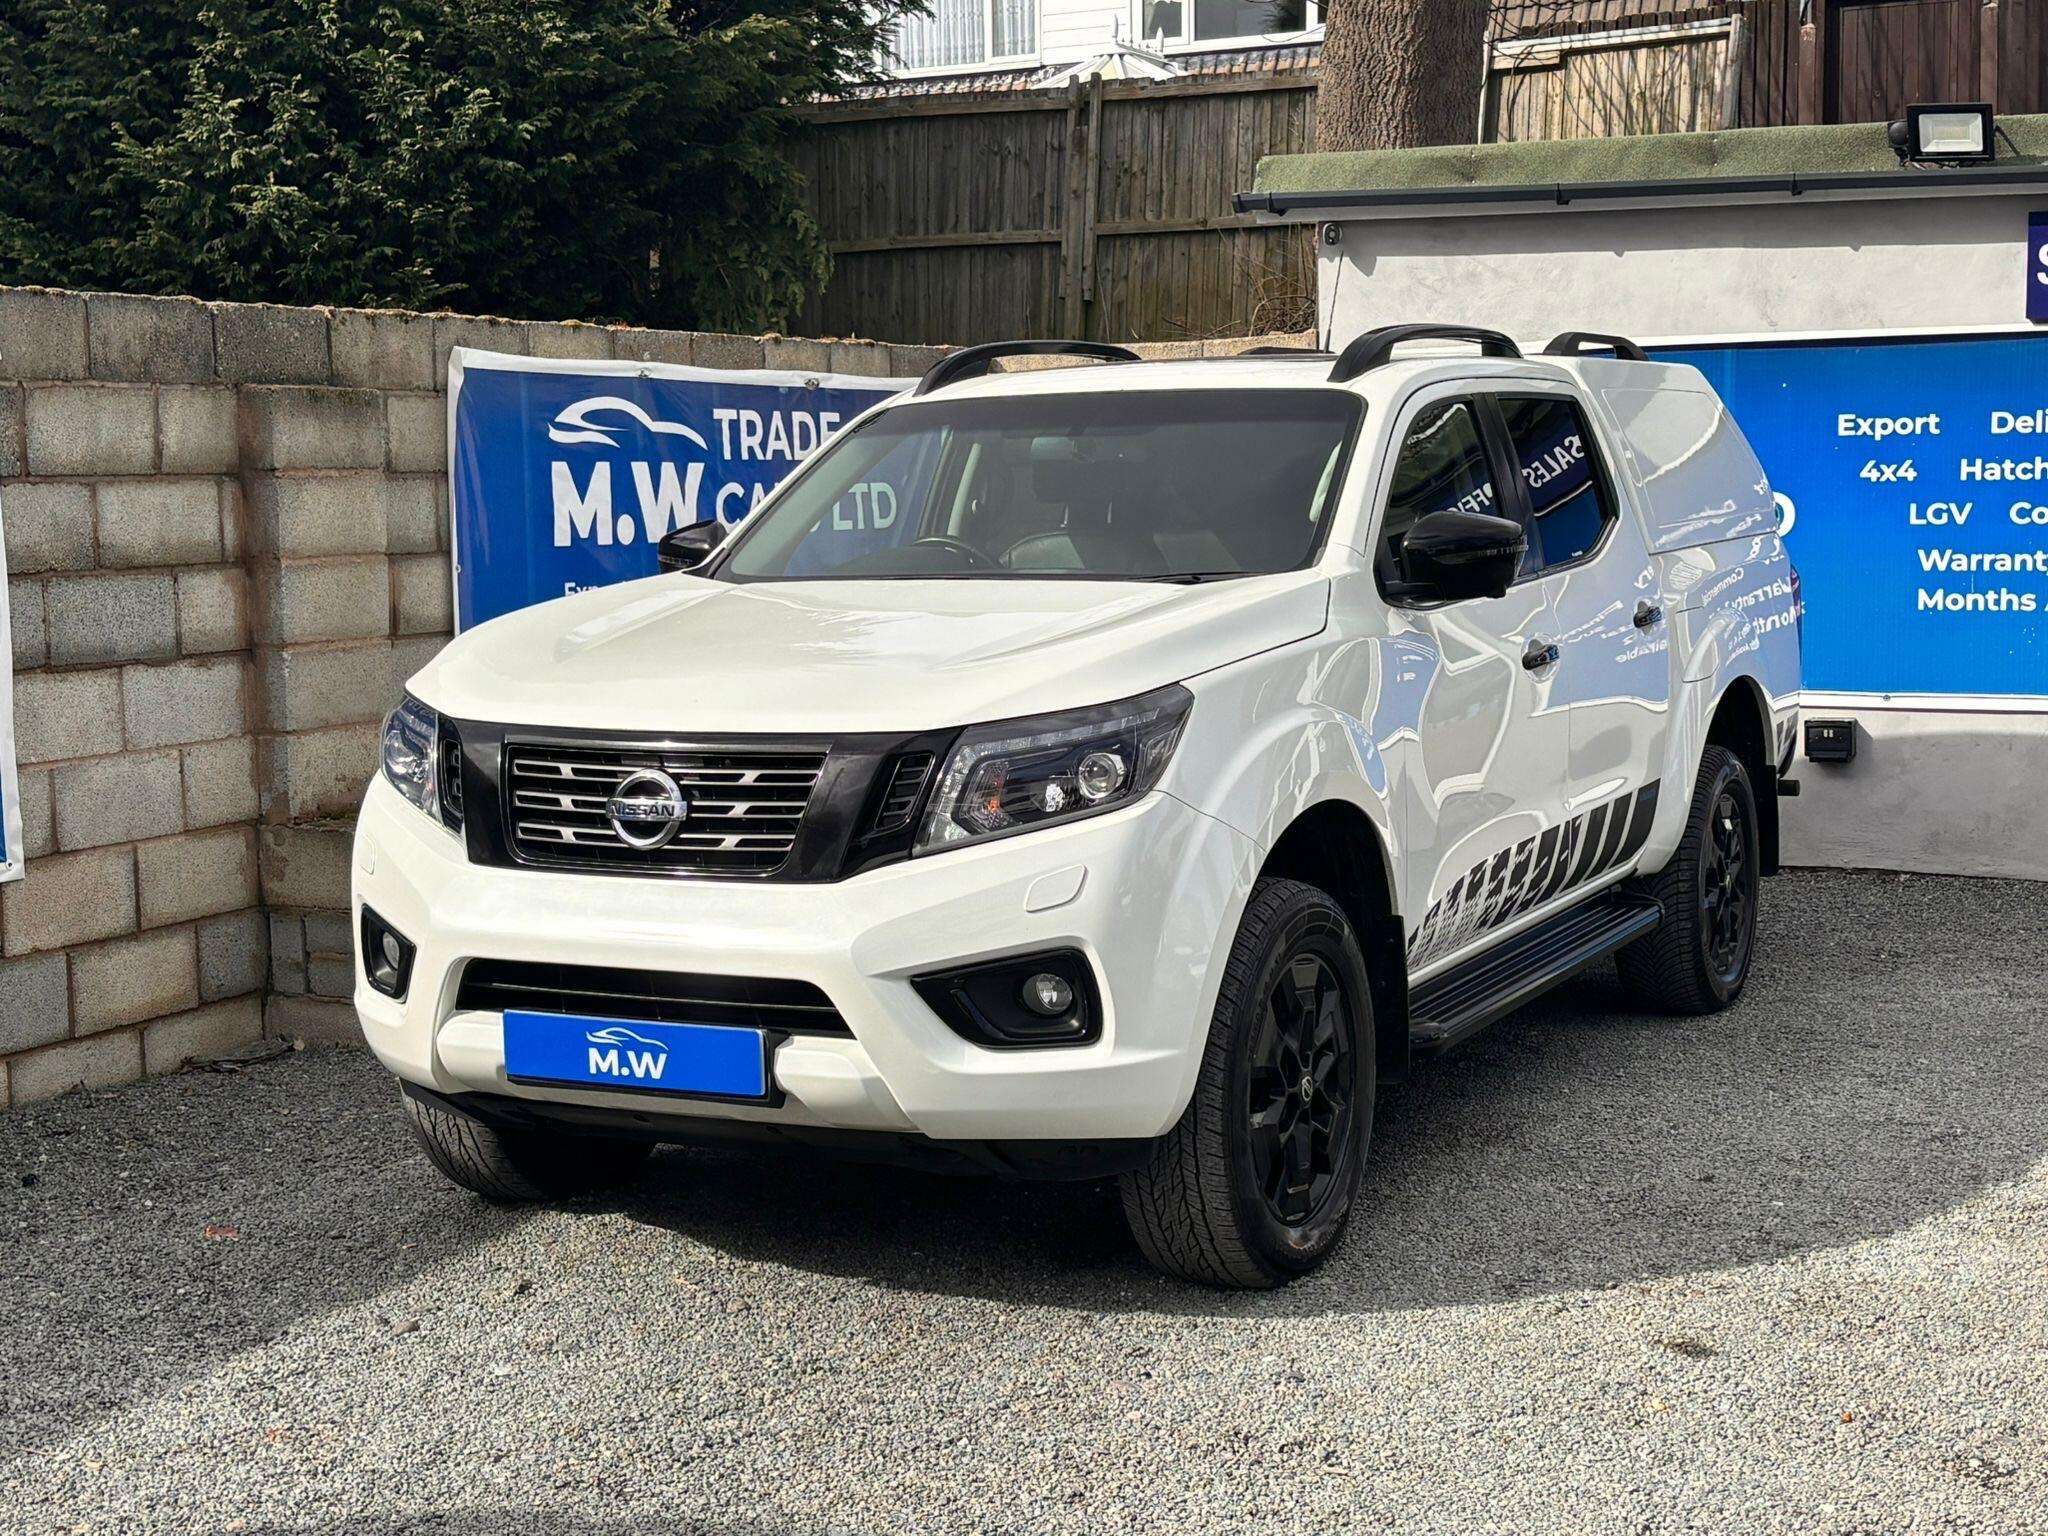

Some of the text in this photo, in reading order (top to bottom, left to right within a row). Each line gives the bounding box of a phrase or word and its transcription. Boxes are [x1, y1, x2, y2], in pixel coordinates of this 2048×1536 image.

[713, 408, 840, 461] TRADE
[1837, 413, 1940, 441] Export
[1859, 459, 1918, 482] 4x4
[551, 461, 705, 547] M.W
[832, 482, 897, 531] LTD
[1909, 502, 1973, 525] LGV
[1917, 549, 2048, 576] Warrant
[1917, 587, 2037, 611] Months
[610, 804, 676, 818] NISSAN
[588, 1047, 667, 1080] M.W
